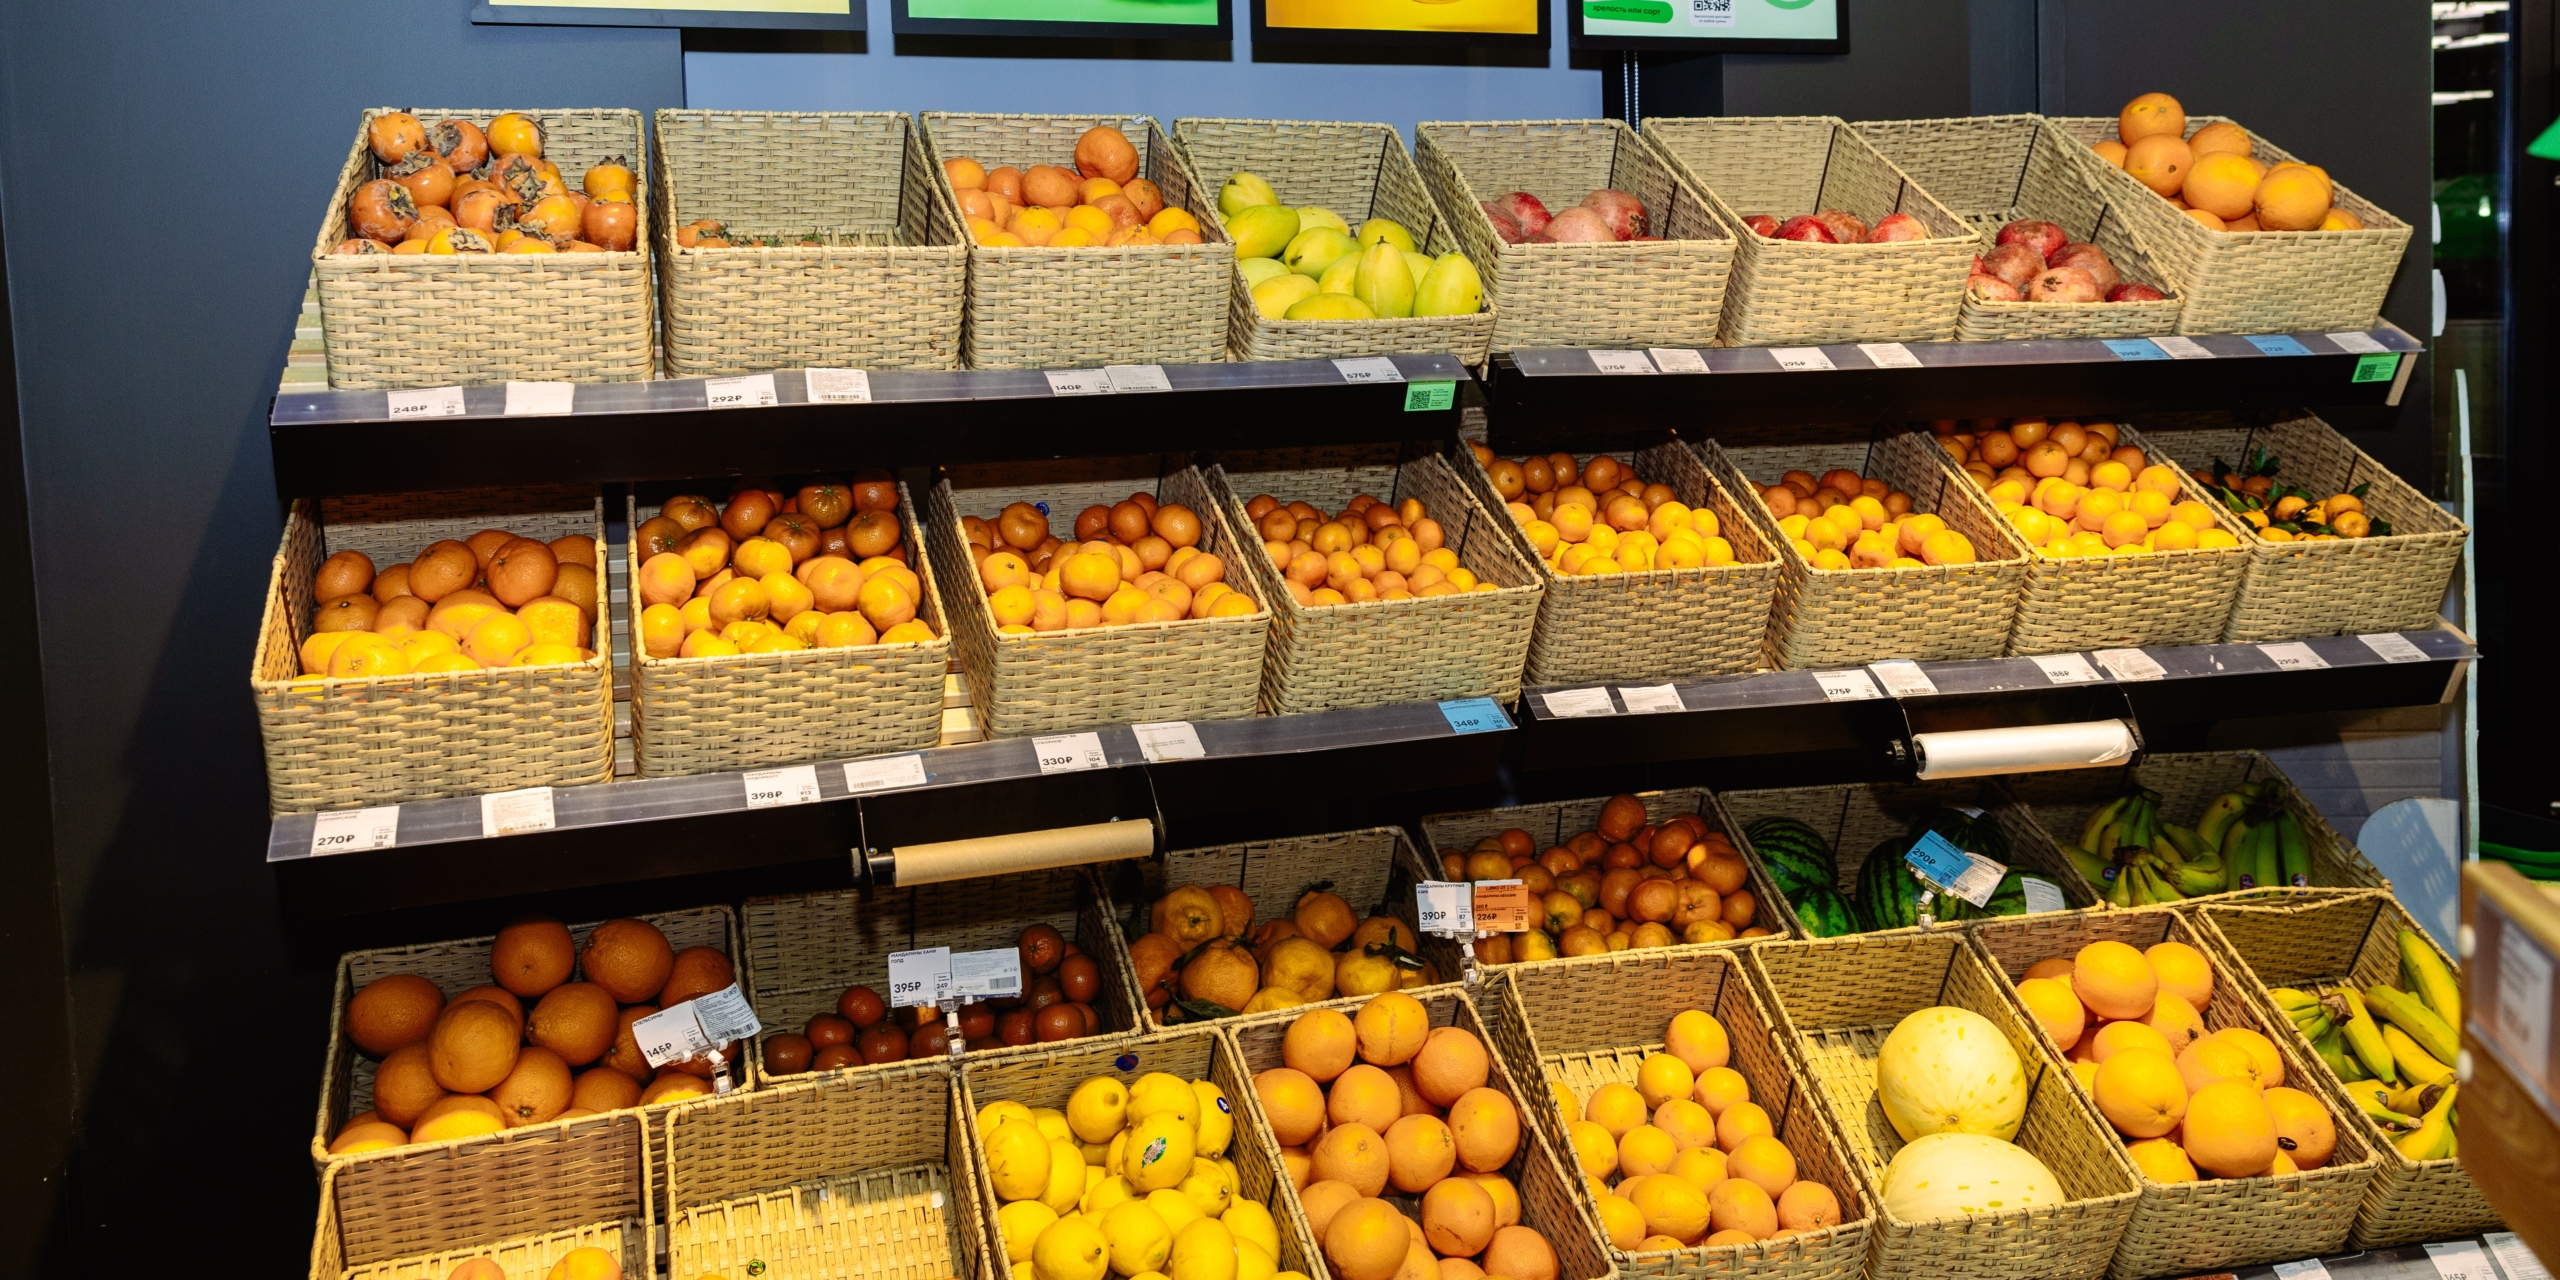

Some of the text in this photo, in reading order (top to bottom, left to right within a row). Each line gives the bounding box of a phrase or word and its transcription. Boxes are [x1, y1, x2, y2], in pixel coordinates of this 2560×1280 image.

[1592, 5, 1626, 13] зрелость
[1643, 8, 1661, 16] сорт
[712, 395, 743, 403] 292₽
[393, 405, 428, 413] 248₽
[1454, 719, 1480, 727] 348₽
[1042, 756, 1073, 766] 330₽
[751, 791, 783, 800] 398₽
[317, 835, 355, 846] 270₽
[1913, 847, 1936, 865] 290₽
[1422, 911, 1447, 920] 390₽
[1477, 913, 1497, 921] 226₽
[894, 981, 921, 993] 395₽
[633, 1013, 663, 1028] АПЕЛЬСИНЫ
[646, 1042, 672, 1058] 145₽
